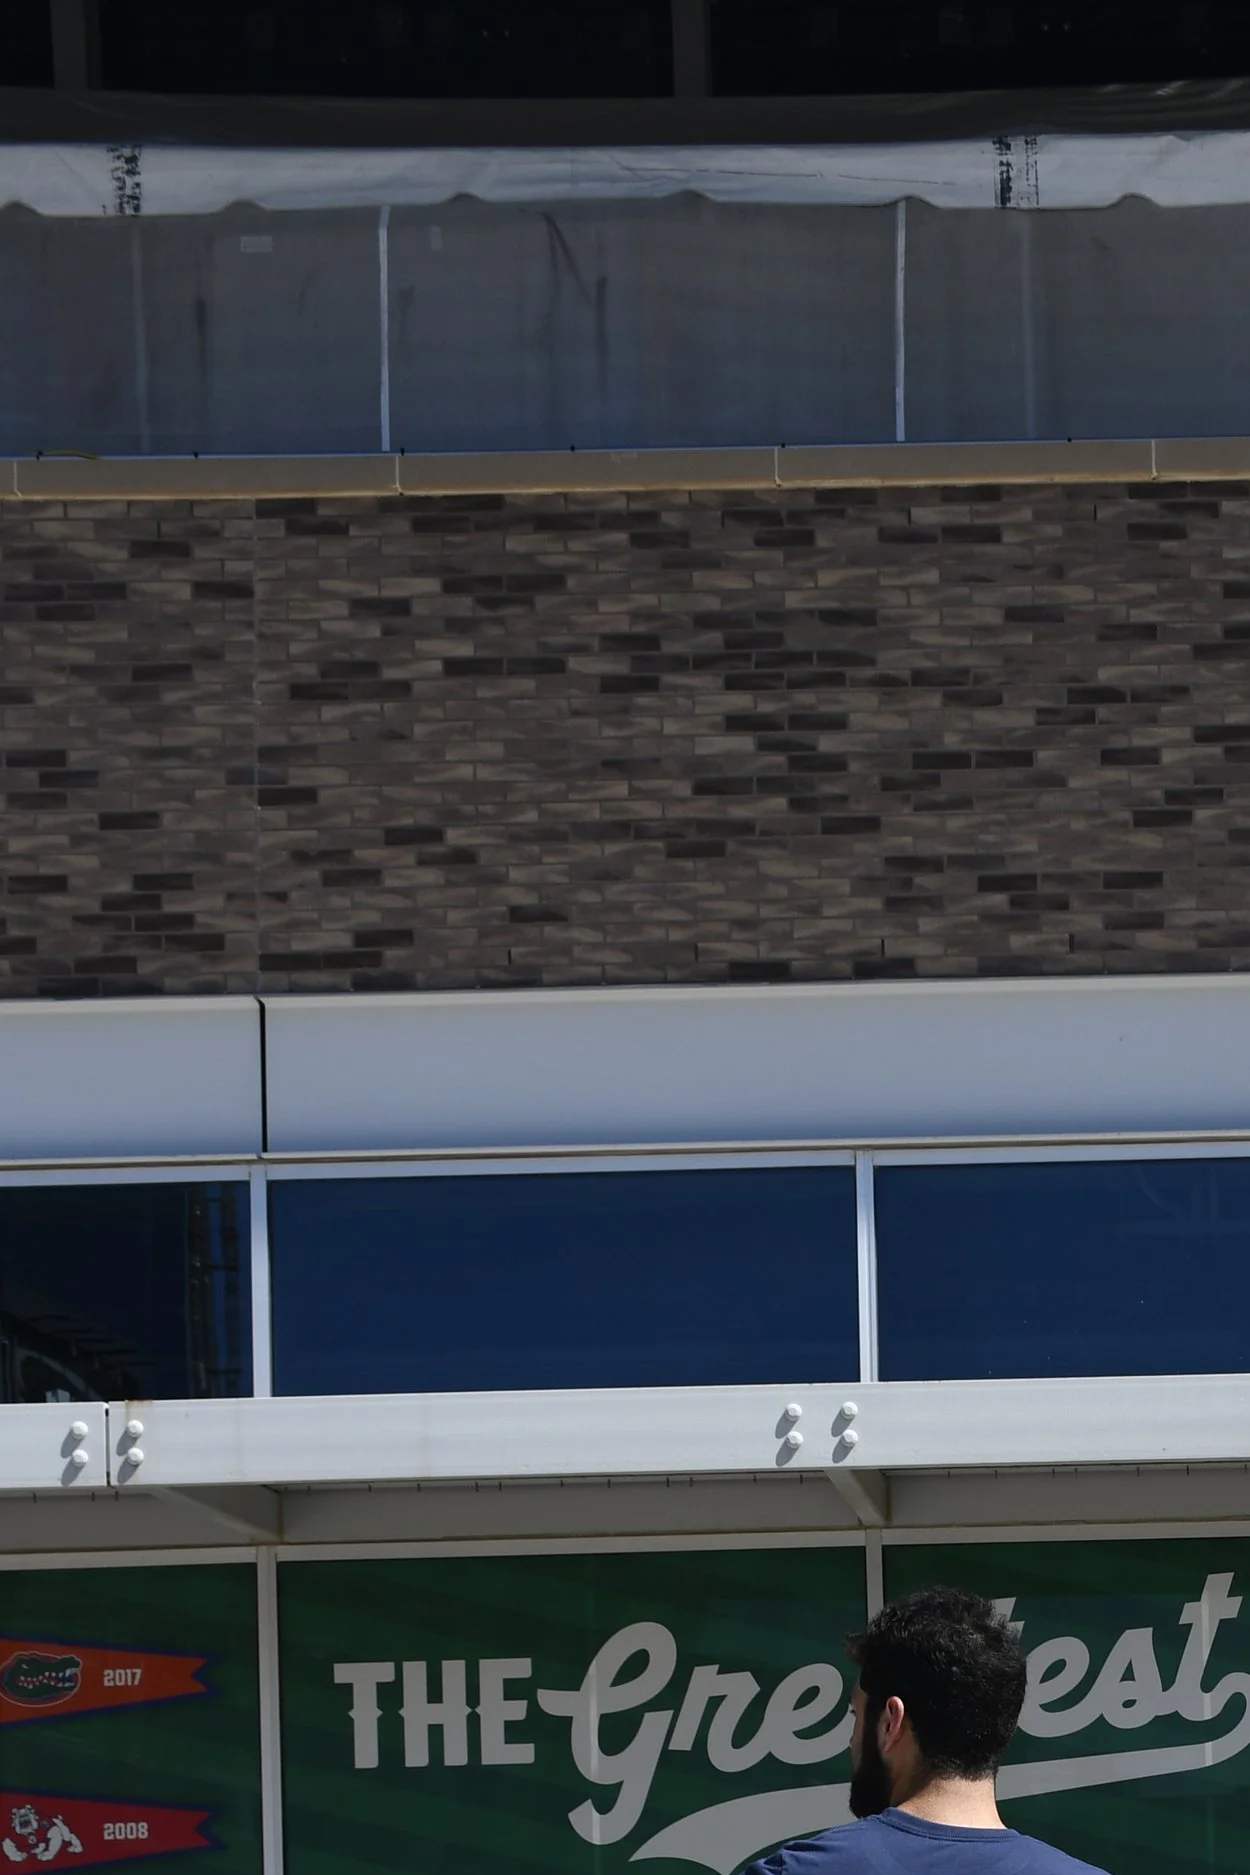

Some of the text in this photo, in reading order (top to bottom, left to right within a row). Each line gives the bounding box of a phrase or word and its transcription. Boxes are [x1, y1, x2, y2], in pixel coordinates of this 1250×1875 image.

[103, 1668, 142, 1687] 2017
[333, 1656, 535, 1770] THE
[103, 1822, 149, 1840] 2008
